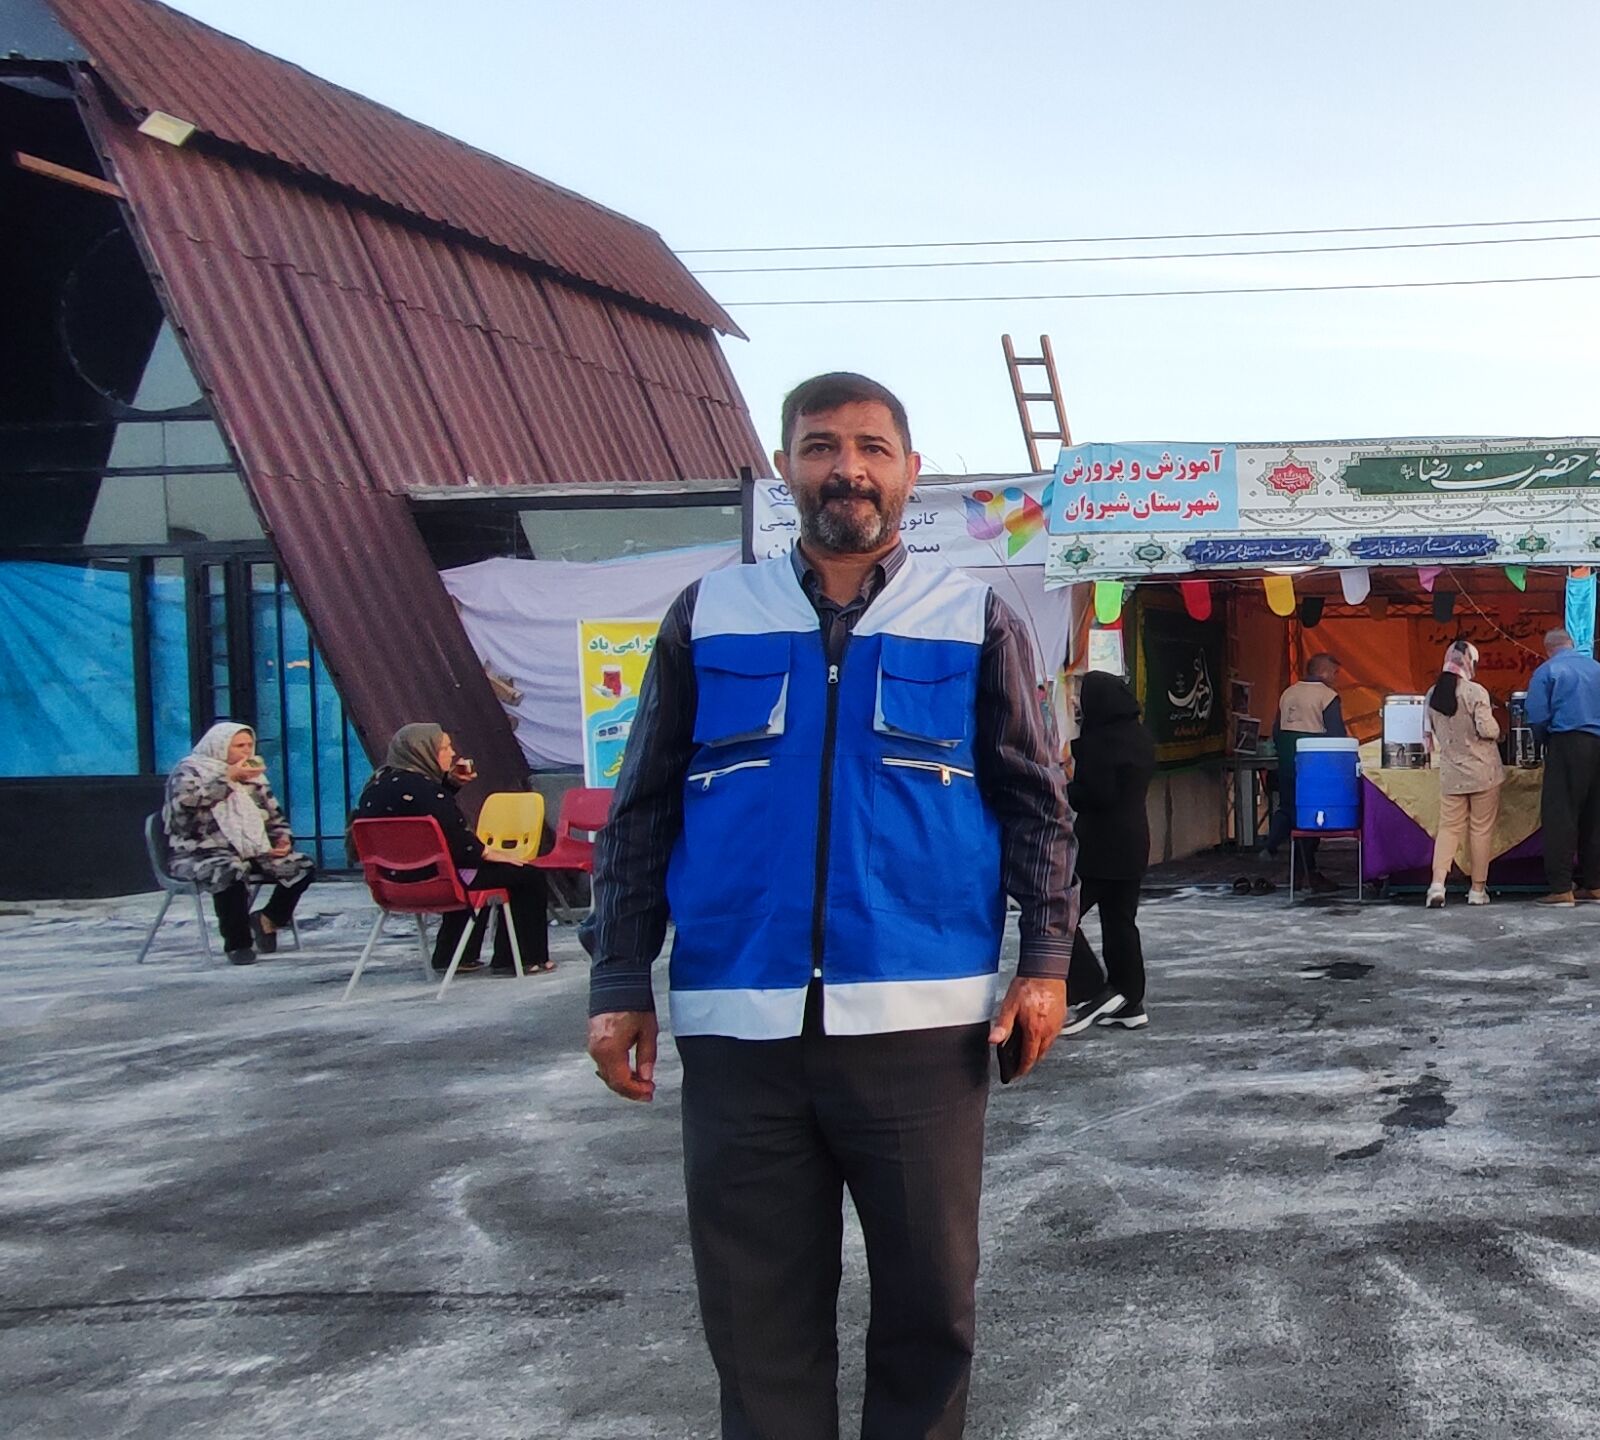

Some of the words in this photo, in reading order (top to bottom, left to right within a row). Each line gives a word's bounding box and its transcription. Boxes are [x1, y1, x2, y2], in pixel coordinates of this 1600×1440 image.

[1063, 457, 1124, 485] پرورش
[1129, 460, 1141, 481] و
[1146, 449, 1223, 480] آموزش
[1417, 457, 1454, 482] رضا
[1430, 452, 1590, 490] حضرت
[1065, 492, 1131, 521] شیروان
[1133, 492, 1220, 520] شهرستان
[760, 516, 797, 532] بیتی
[589, 637, 609, 653] باد
